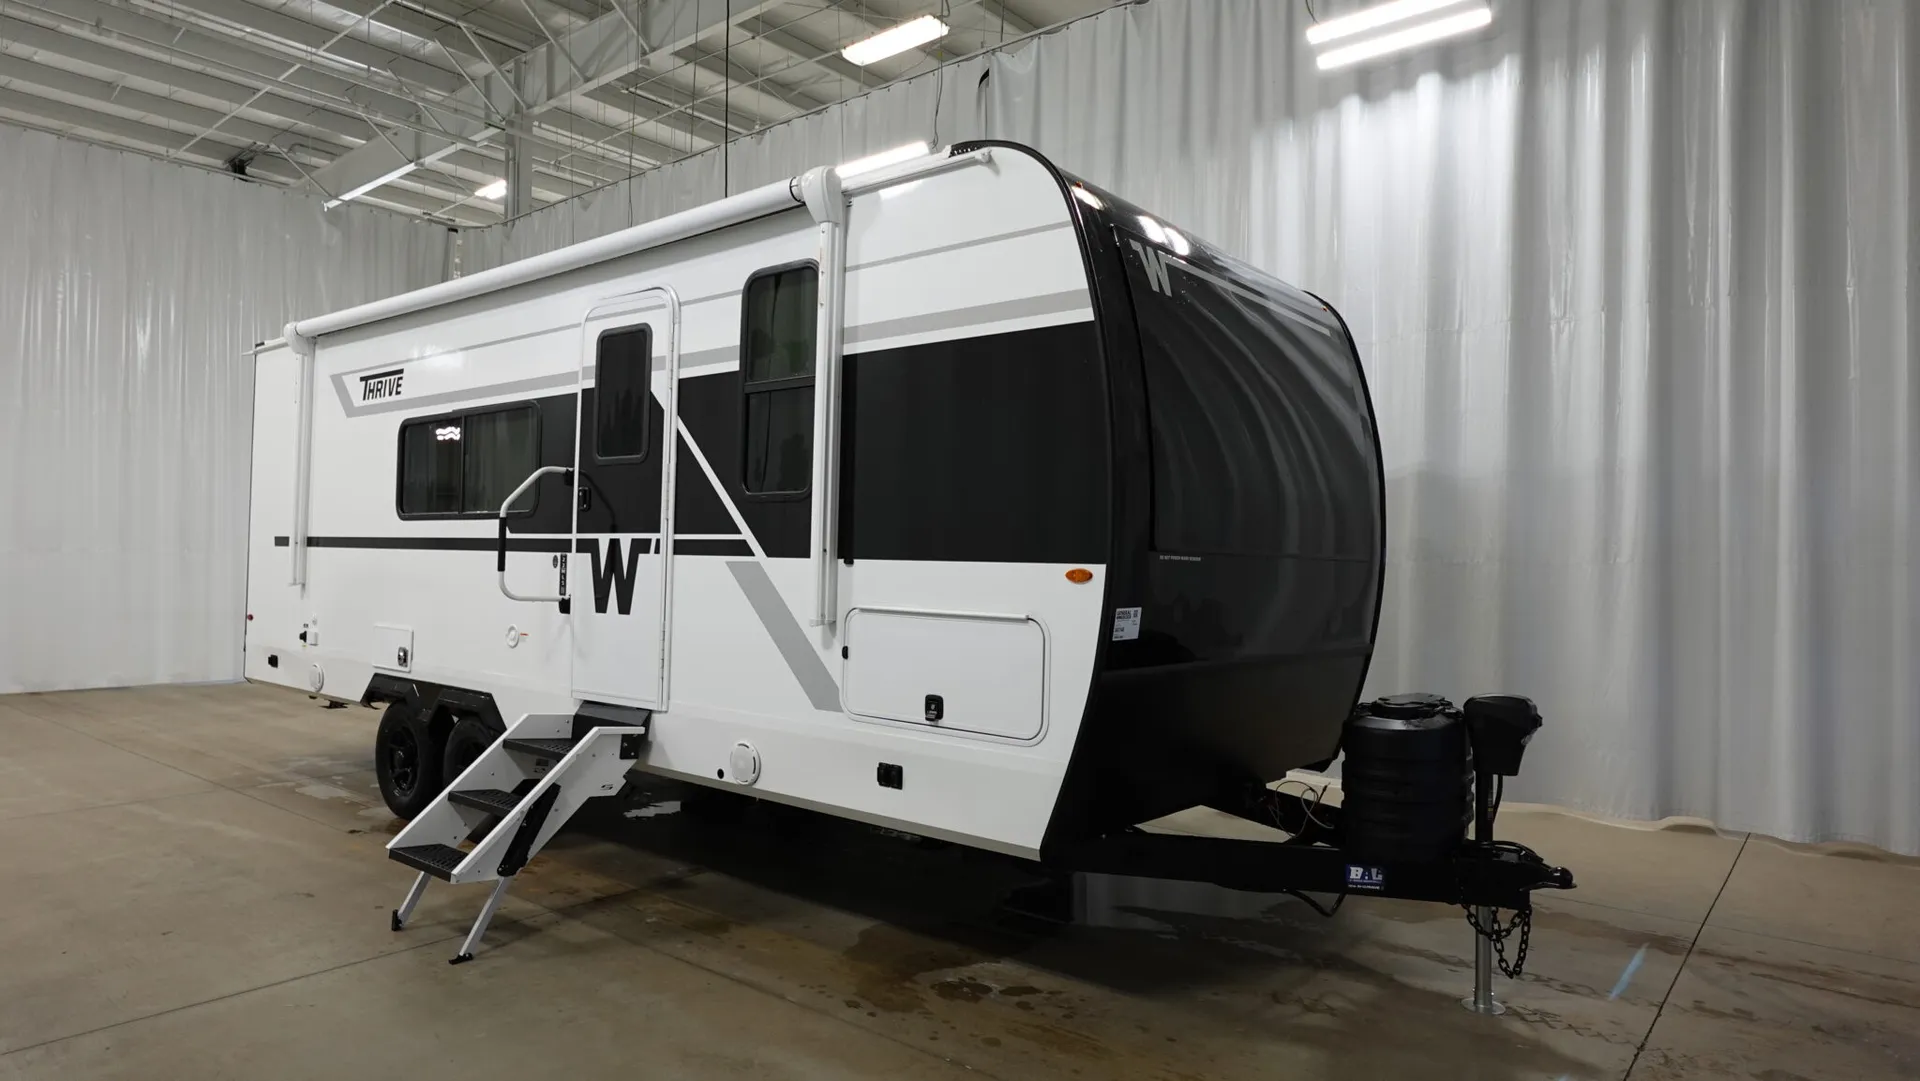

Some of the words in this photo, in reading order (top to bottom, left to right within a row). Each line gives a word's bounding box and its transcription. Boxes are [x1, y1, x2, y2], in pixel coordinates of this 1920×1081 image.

[1129, 238, 1172, 297] W
[360, 368, 404, 401] THRIVE
[576, 538, 652, 615] W
